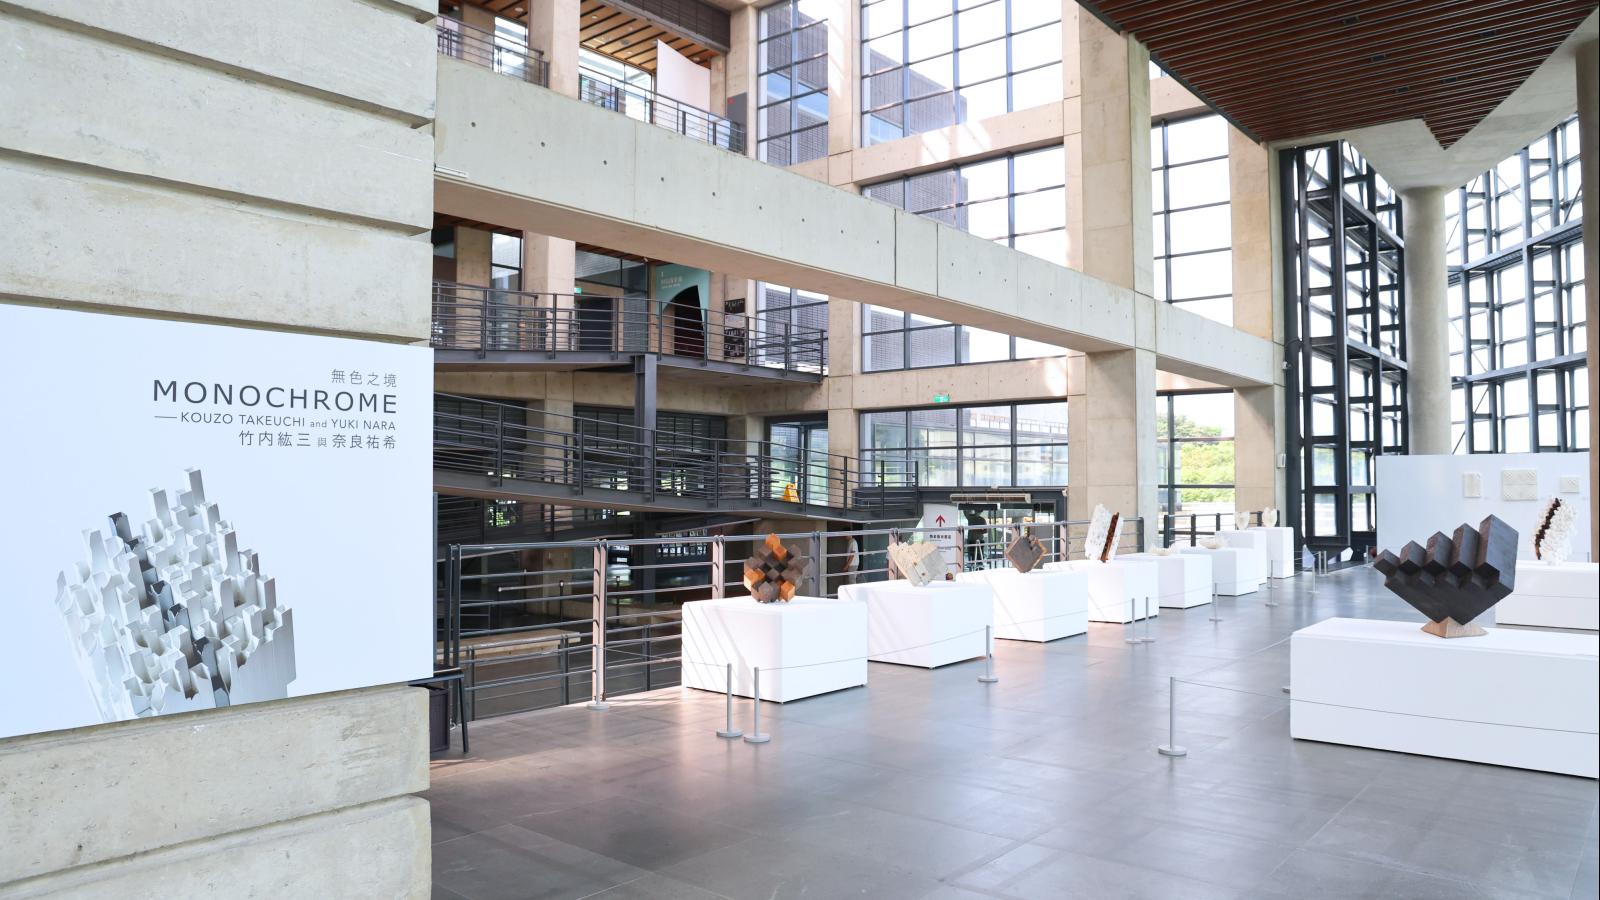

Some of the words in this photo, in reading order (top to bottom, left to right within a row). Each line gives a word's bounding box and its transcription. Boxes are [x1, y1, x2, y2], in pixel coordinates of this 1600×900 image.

[331, 368, 397, 388] 無色之境
[153, 379, 397, 414] MONOCHROME
[238, 414, 305, 427] TAKEUCHI
[309, 419, 328, 429] and
[331, 418, 359, 430] YUKI
[363, 419, 396, 431] NARA
[331, 433, 397, 449] 奈良祐希
